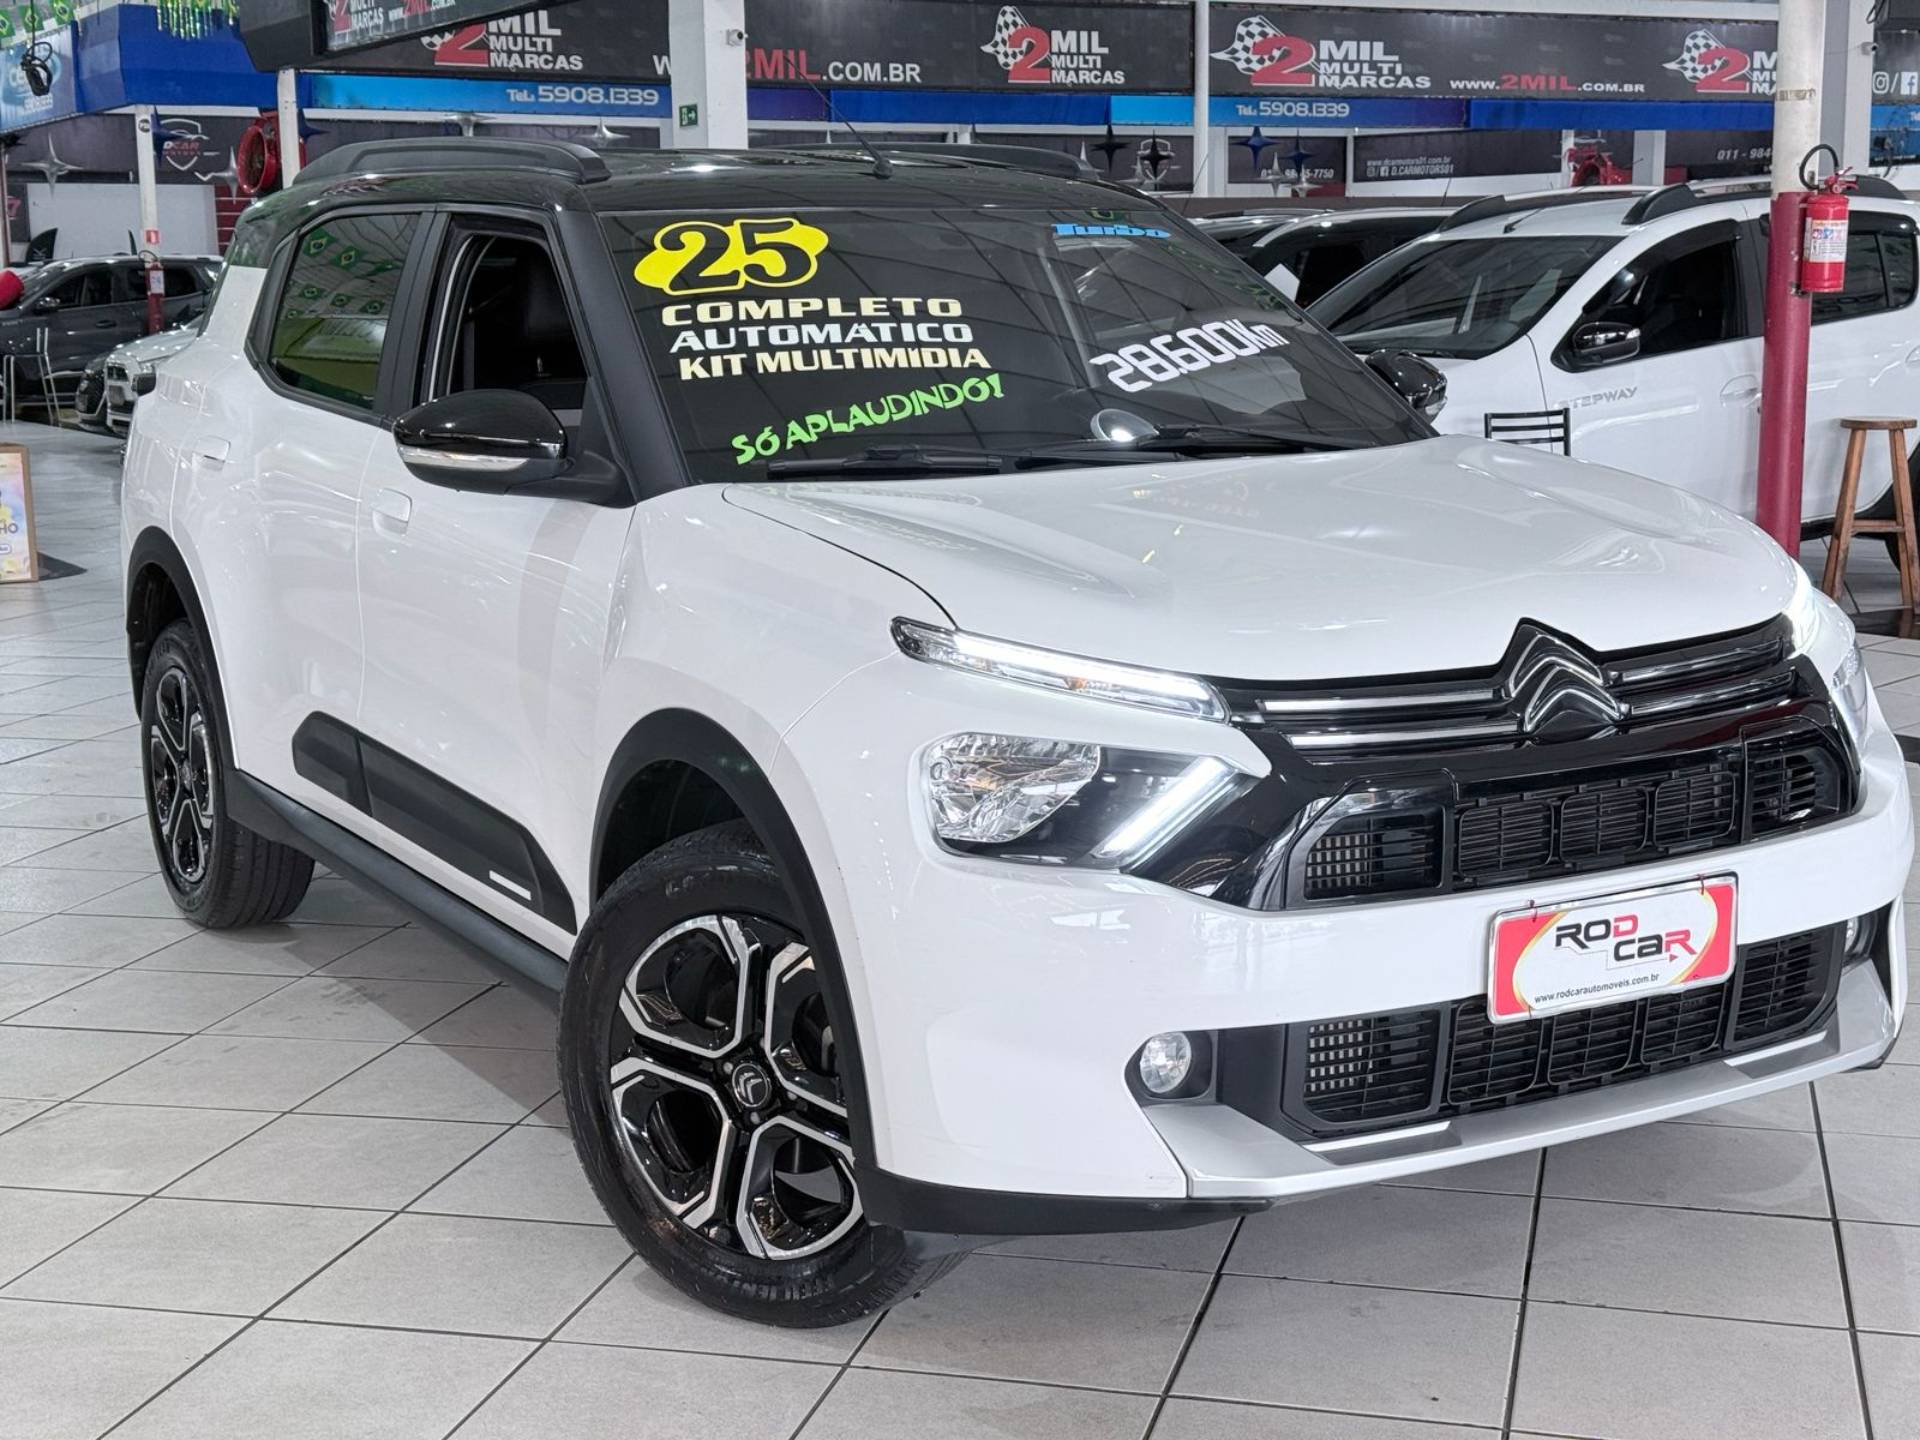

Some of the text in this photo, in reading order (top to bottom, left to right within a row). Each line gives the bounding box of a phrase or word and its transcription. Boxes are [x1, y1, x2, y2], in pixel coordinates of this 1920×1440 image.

[488, 10, 562, 36] MIL
[489, 35, 553, 53] MULTI
[1050, 30, 1110, 54] MIL
[1318, 40, 1400, 62] MIL
[489, 52, 584, 71] MARCAS
[1050, 55, 1102, 69] MULTI
[1318, 61, 1403, 76] MULTI
[1050, 70, 1126, 85] MARCAS
[1318, 75, 1432, 90] MARCAS
[537, 85, 660, 106] 5908.1339
[1259, 101, 1351, 118] 5908.1339
[655, 218, 816, 294] 25
[661, 297, 963, 326] COMPLETO
[678, 353, 748, 381] KIT
[731, 372, 1005, 466] SÓ APLAUDINDO!
[1534, 973, 1660, 1004] www.rodcarautomoveis.com.br
